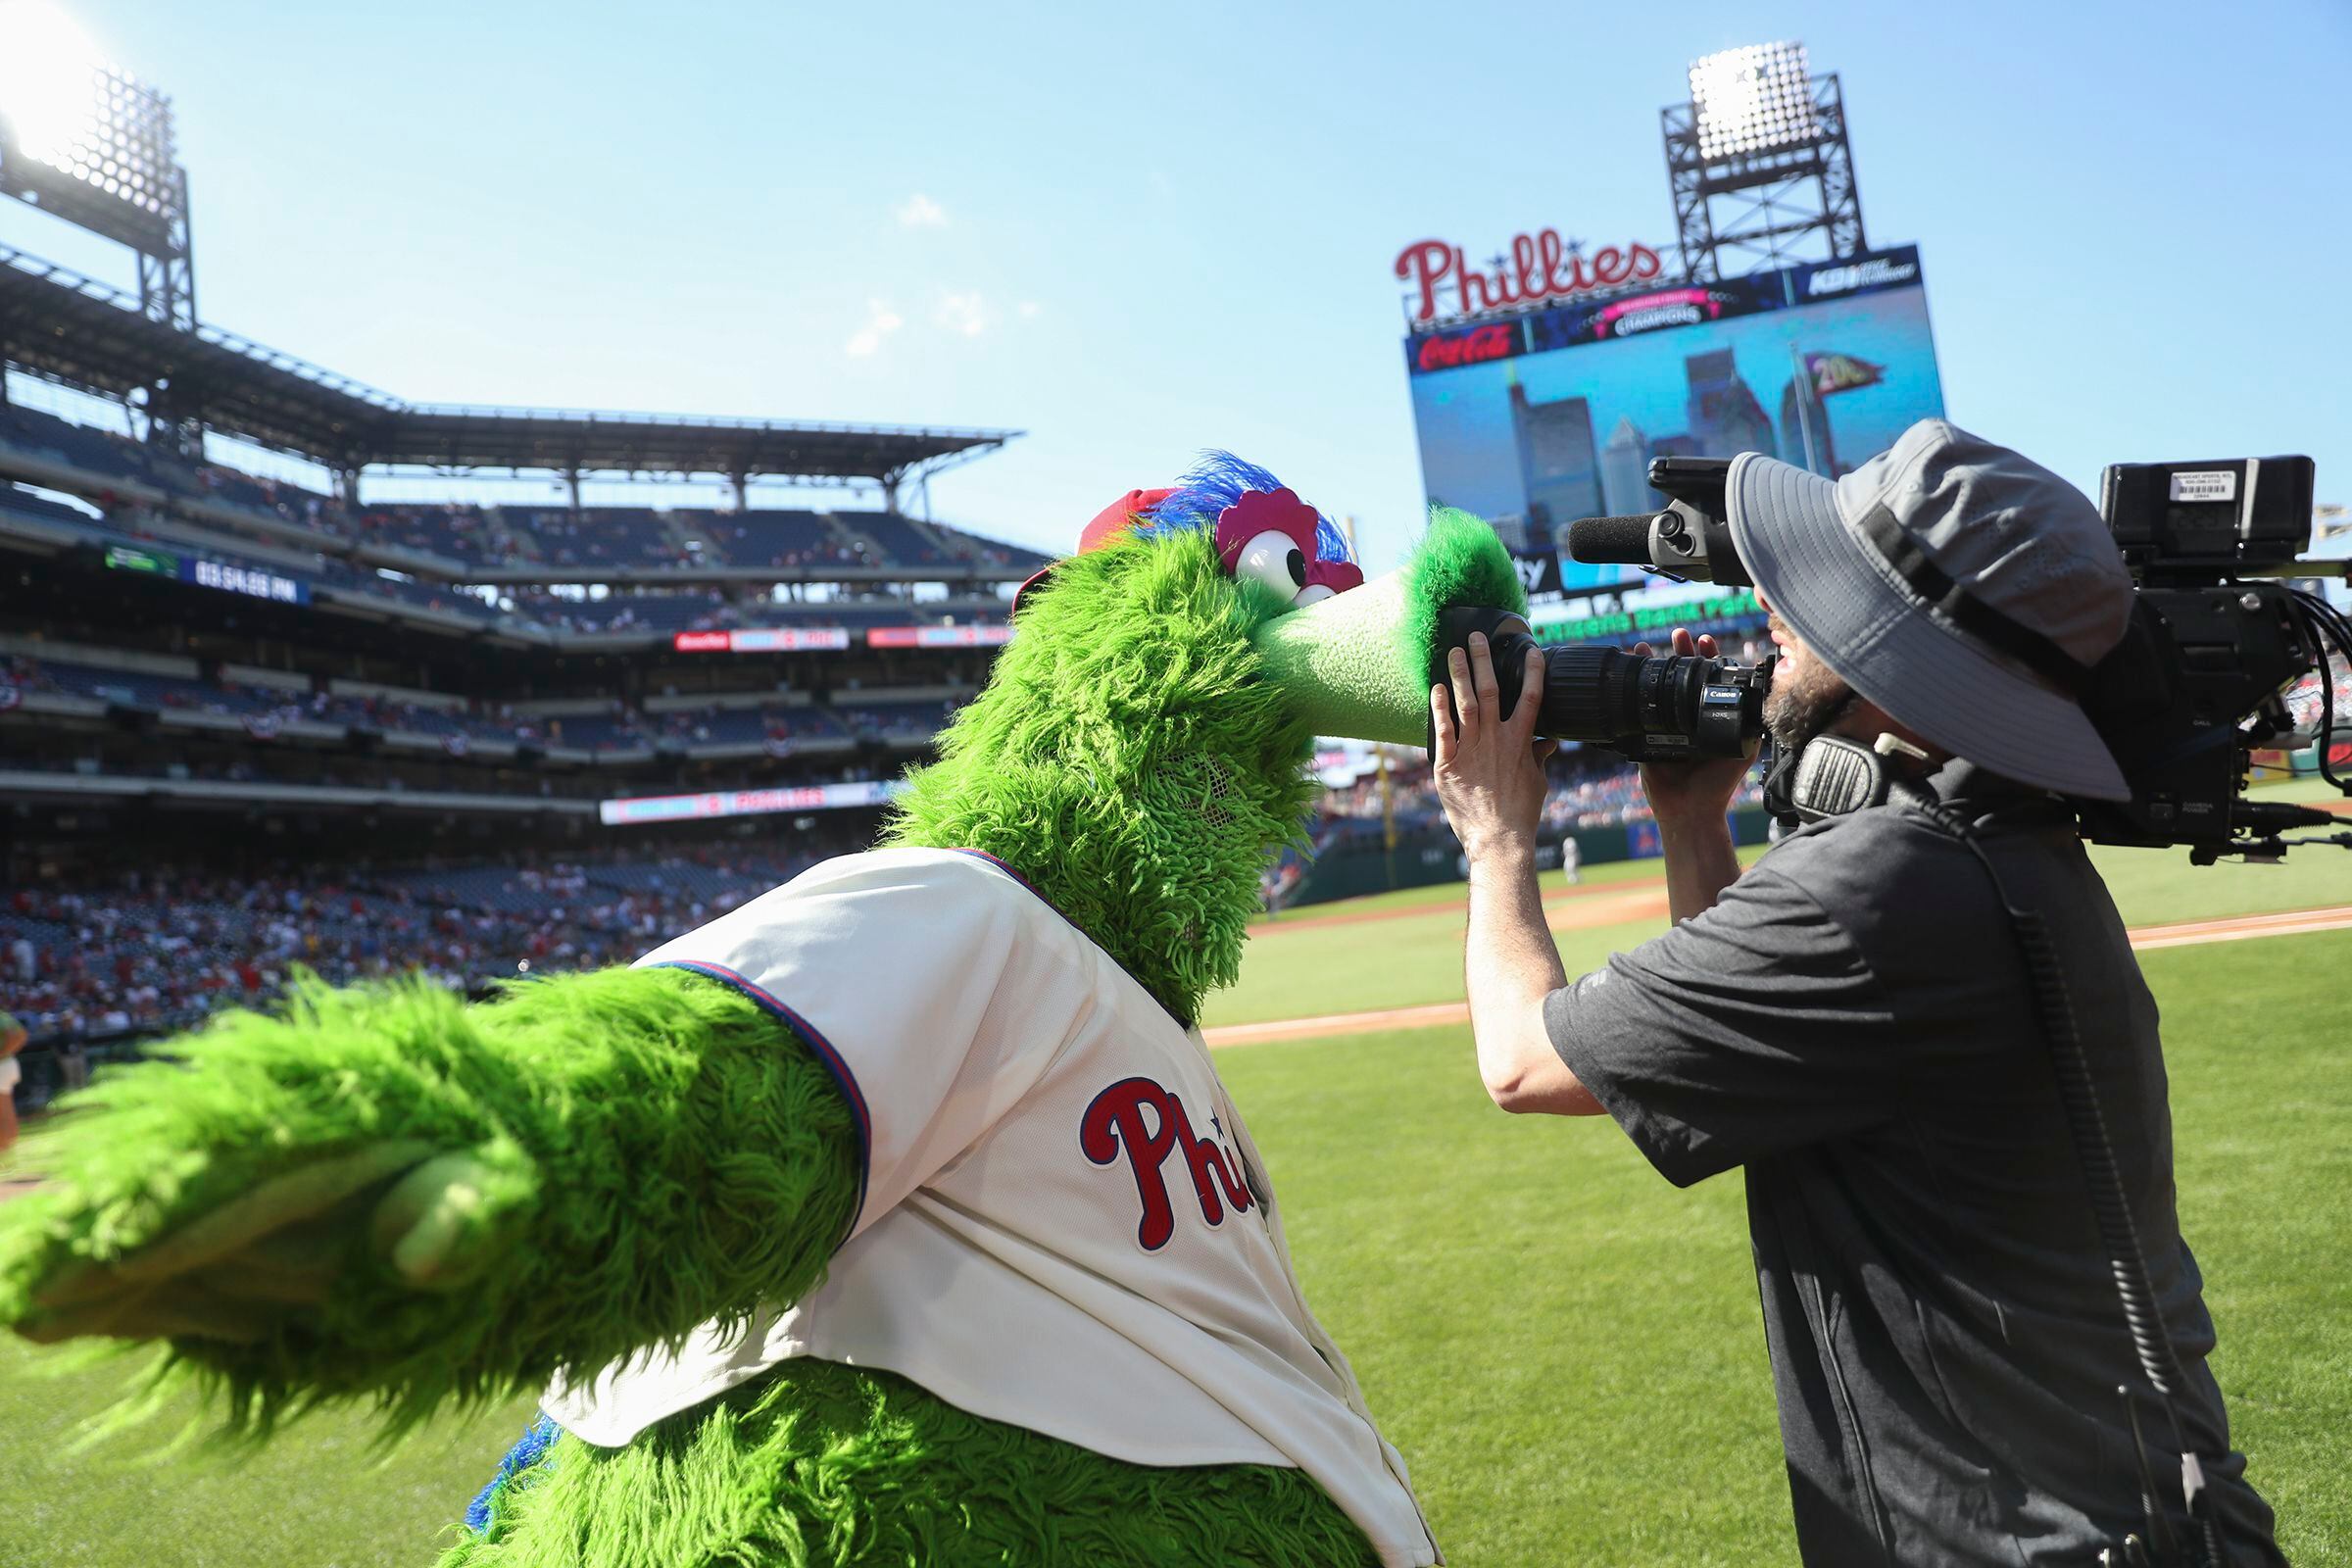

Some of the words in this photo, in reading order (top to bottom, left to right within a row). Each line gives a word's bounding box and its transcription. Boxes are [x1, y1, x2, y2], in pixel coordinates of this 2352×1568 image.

[1395, 228, 1661, 321] Phillies
[1635, 600, 1700, 630] Bank
[1709, 690, 1738, 699] Canon
[1080, 1076, 1254, 1251] Phi
